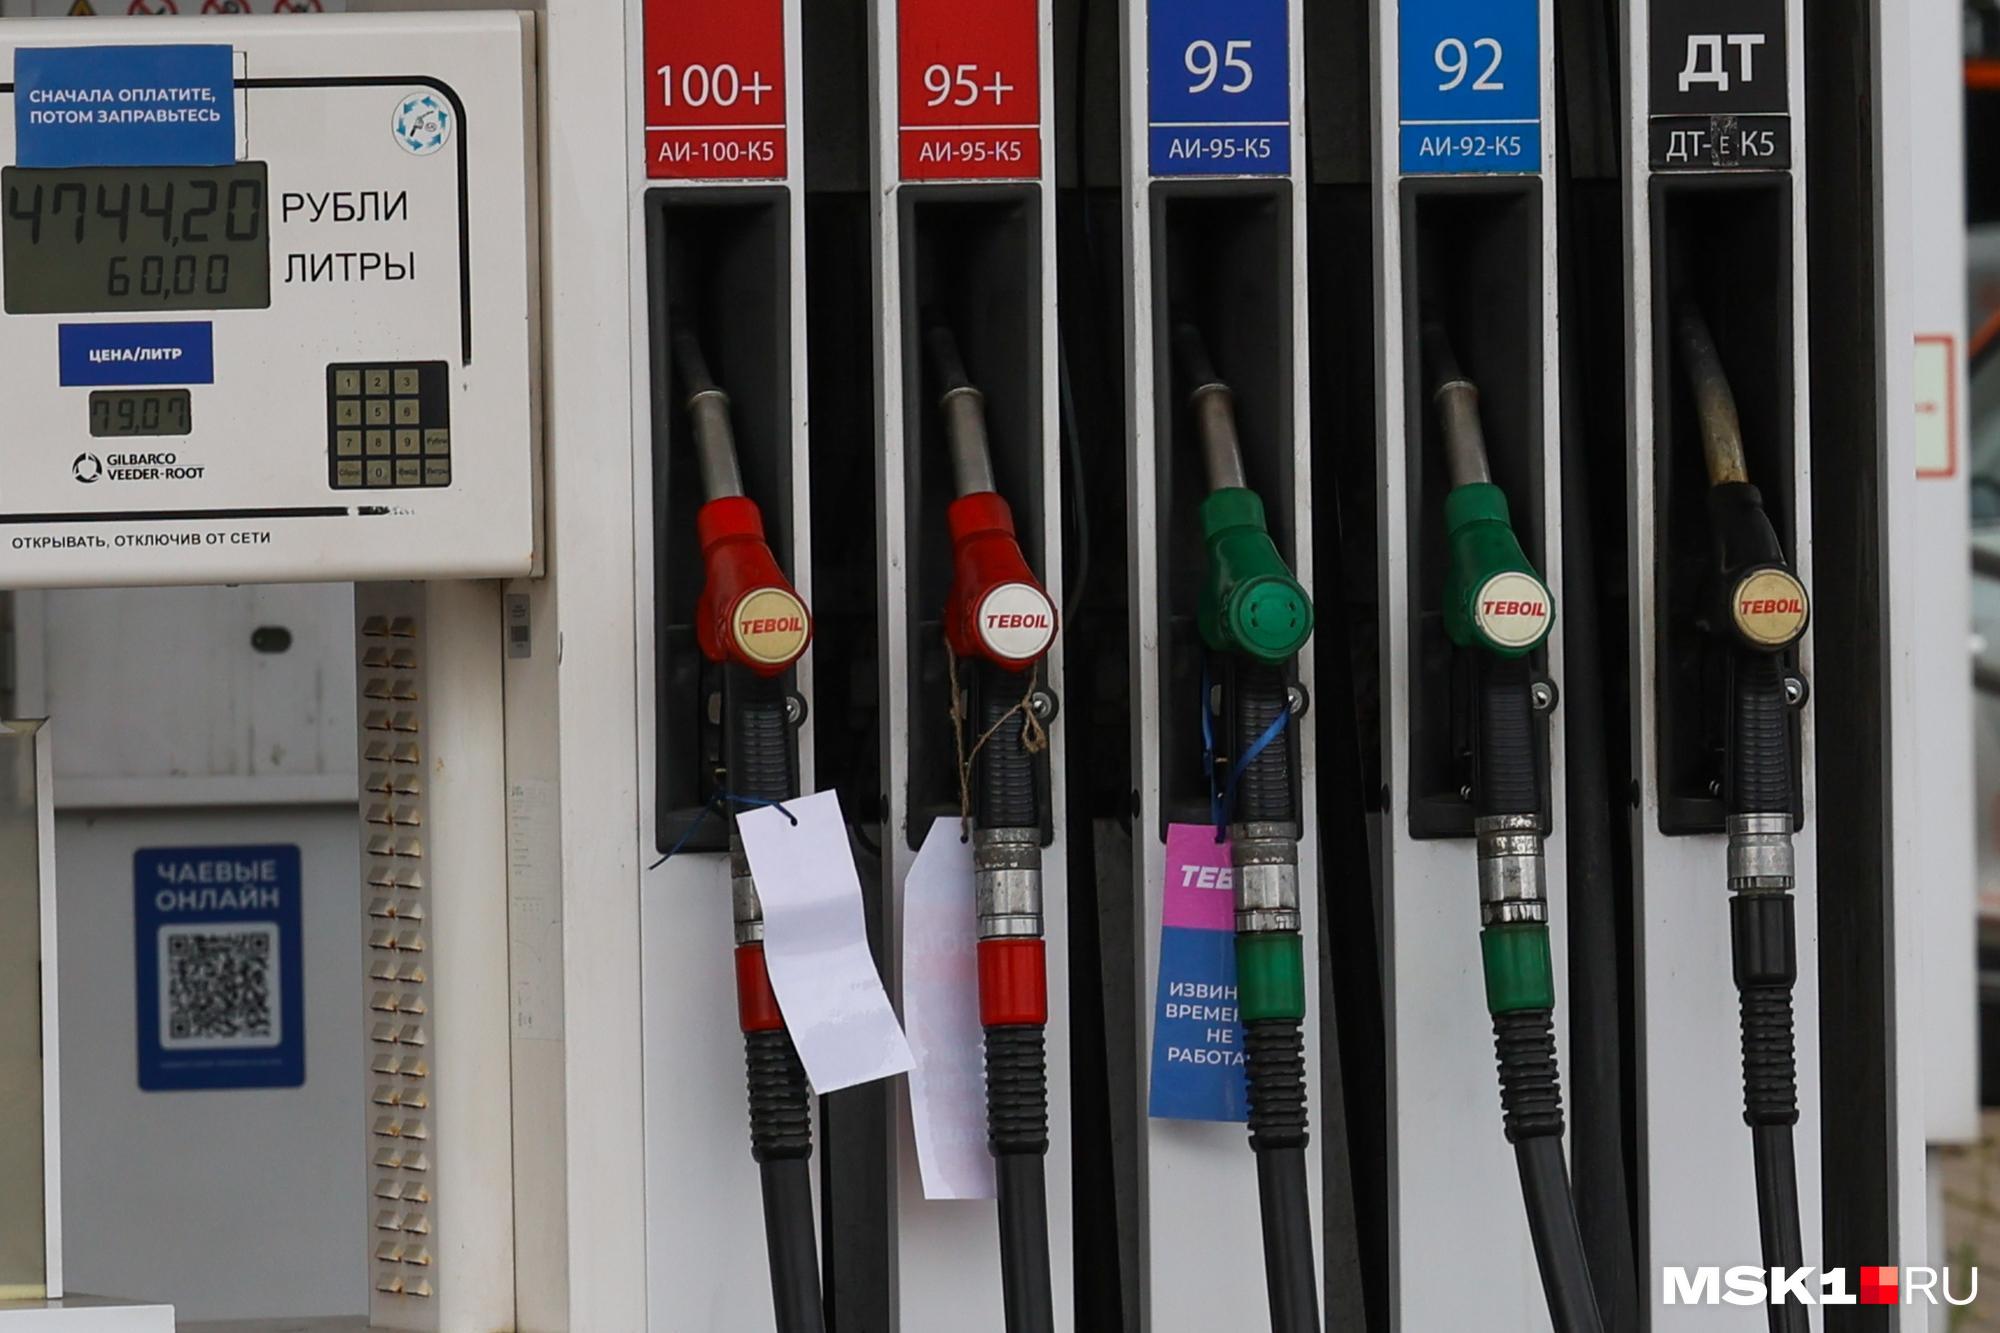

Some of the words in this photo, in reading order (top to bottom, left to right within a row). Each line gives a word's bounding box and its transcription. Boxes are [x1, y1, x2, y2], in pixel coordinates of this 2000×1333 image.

[1184, 39, 1254, 94] 95
[1434, 37, 1504, 92] 92
[1678, 33, 1765, 92] ДТ
[29, 88, 114, 104] СНАЧАЛА
[118, 87, 217, 104] ОПЛАТИТЕ,
[655, 63, 773, 107] 100+
[923, 63, 1014, 107] 95+
[30, 109, 94, 124] ПОТОМ
[97, 108, 221, 124] ЗАПРАВЬТЕСЬ
[658, 141, 775, 163] АИ-100-К5
[919, 140, 1022, 163] АИ-95-К5
[1169, 137, 1271, 160] АИ-95-К5
[1419, 135, 1521, 158] АИ-92-К5
[7, 177, 263, 247] 4744,20
[281, 189, 409, 223] РУБЛИ
[108, 255, 230, 300] 60,00
[284, 251, 415, 284] ЛИТРЫ
[88, 346, 183, 364] ЦЕНА/ЛИТР
[106, 452, 176, 467] GILBARCO
[107, 466, 205, 481] VEEDER-ROOT
[11, 535, 112, 551] ОТКРЫВАТЬ,
[114, 534, 201, 548] ОТКЛЮЧИВ
[205, 533, 226, 546] ОТ
[230, 531, 271, 546] СЕТИ
[1483, 601, 1546, 617] TEBOIL
[1740, 598, 1803, 615] TEBOIL
[741, 616, 803, 635] TEBOIL
[984, 613, 1049, 631] TEBOIL
[157, 860, 277, 884] ЧАЕВЫЕ
[155, 883, 280, 912] ОНЛАЙН
[1169, 981, 1238, 1000] ИЗВИН
[1206, 1028, 1233, 1044] НЕ
[1167, 1047, 1249, 1067] РАБОТА
